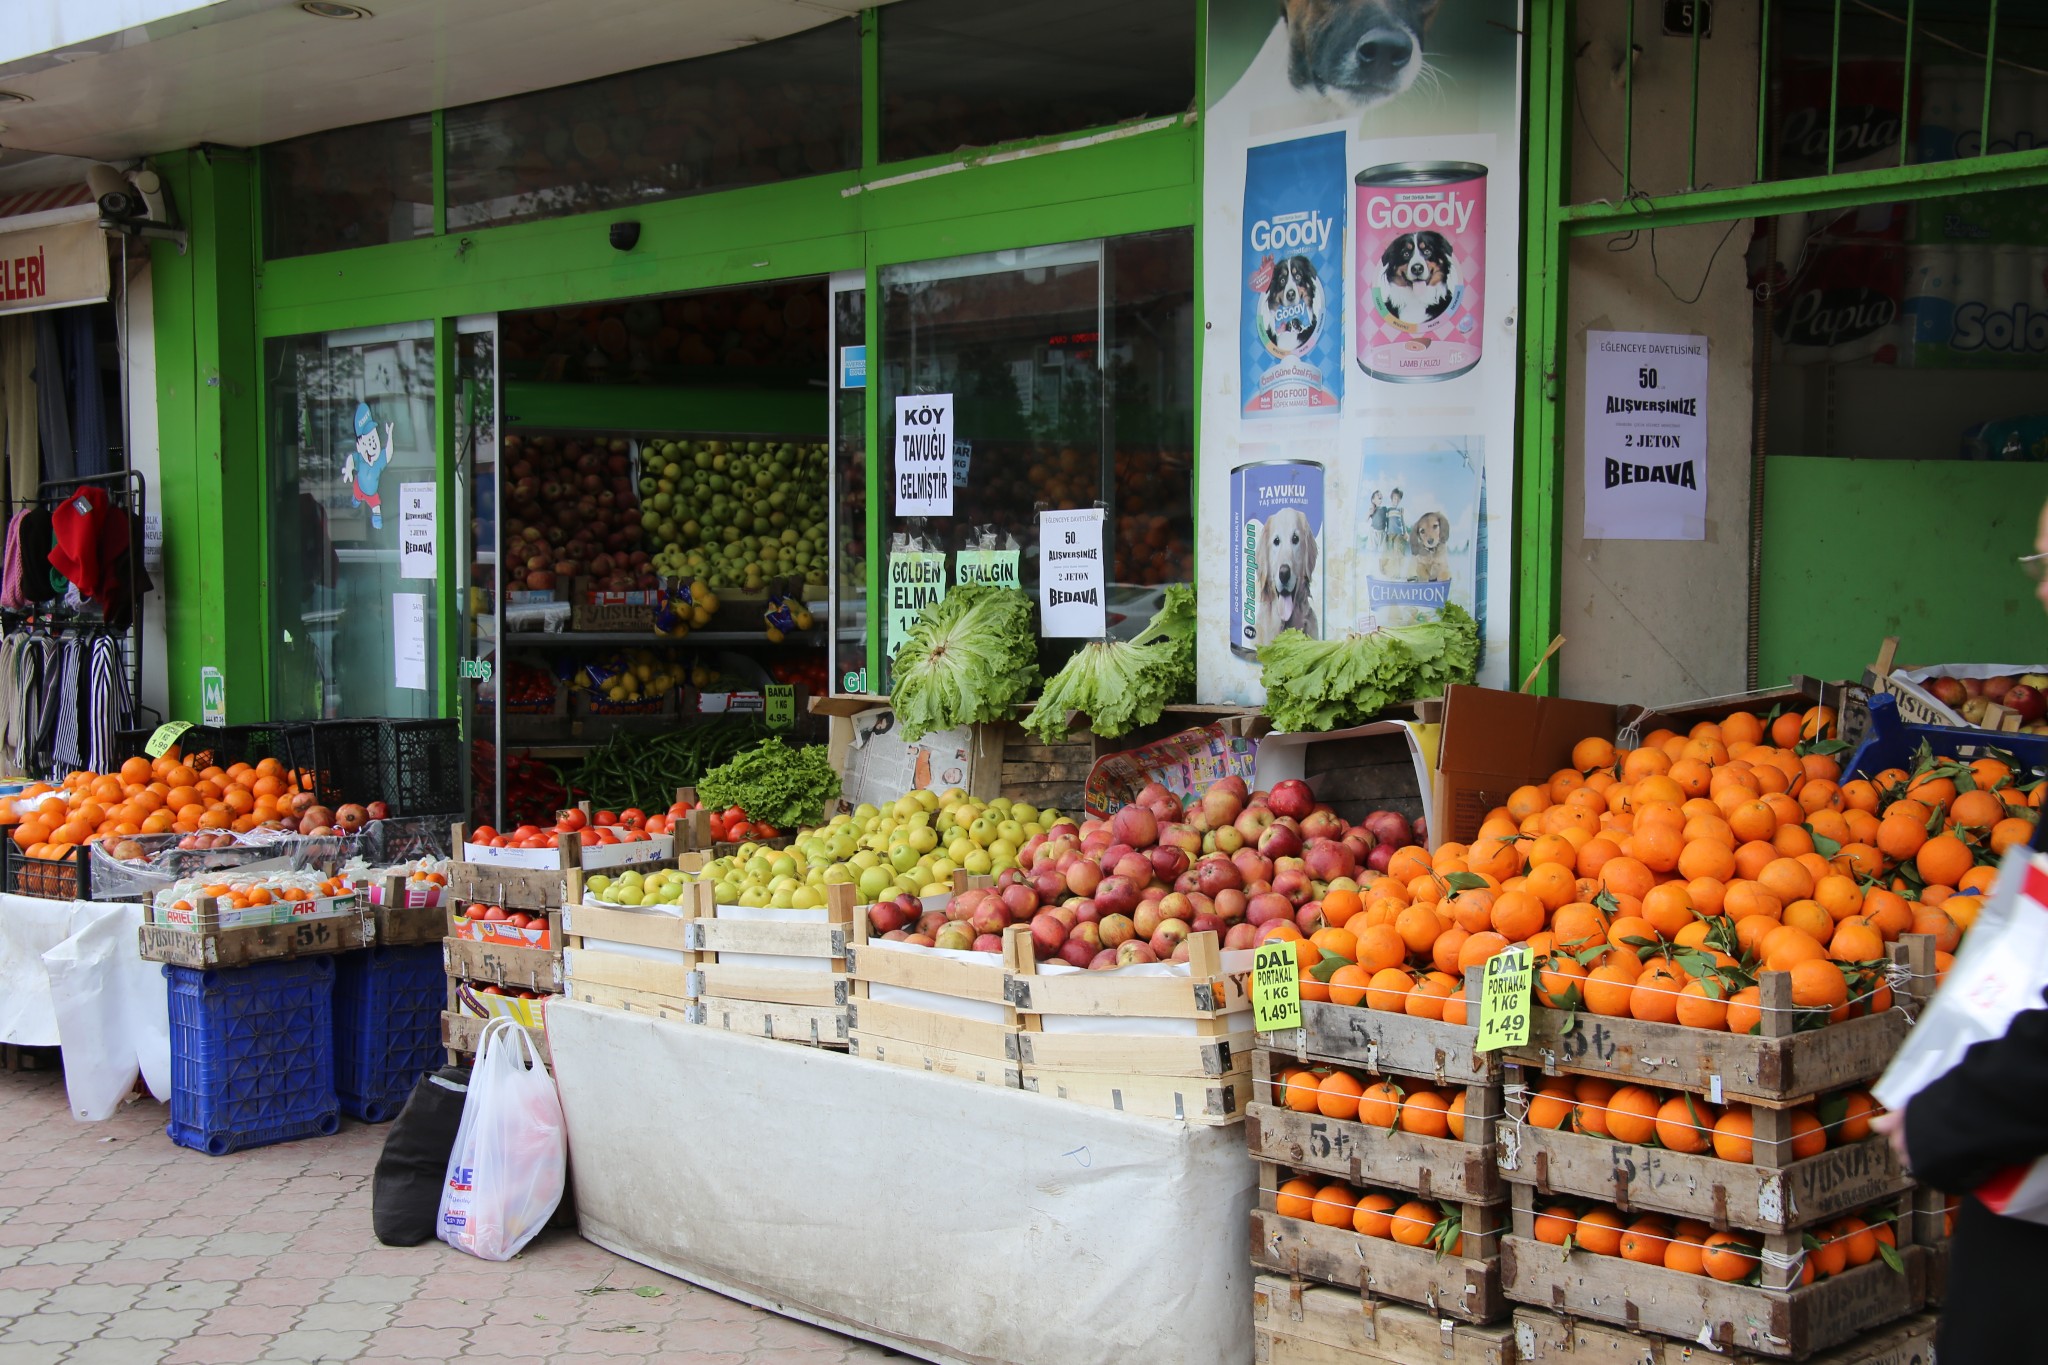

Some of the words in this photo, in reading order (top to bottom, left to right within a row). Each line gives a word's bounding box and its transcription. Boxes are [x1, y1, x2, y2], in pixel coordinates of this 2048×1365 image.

[1682, 4, 1693, 27] 5
[1367, 191, 1476, 234] Goody
[1250, 210, 1333, 252] Goody
[1275, 302, 1306, 322] Goody
[1780, 287, 1890, 347] Papia
[1600, 341, 1647, 353] EĞLENCEYE
[1649, 344, 1701, 355] DAVETLİSİNİZ
[1400, 360, 1418, 368] LAMB
[1424, 359, 1441, 367] KUZU
[1639, 368, 1658, 389] 50
[1273, 389, 1288, 398] DOG
[1289, 388, 1308, 398] FOOD
[904, 405, 945, 426] KÖY
[1606, 395, 1697, 417] ALIŞVERŞİNİZE
[903, 426, 946, 462] TAVUĞU
[1625, 434, 1633, 448] 2
[1636, 434, 1681, 449] JETON
[1605, 456, 1697, 491] BEDAVA
[900, 465, 948, 507] GELMİŞTİR
[1259, 485, 1306, 499] TAVUKLU
[413, 498, 421, 509] 50
[405, 540, 433, 556] BEDAVA
[1065, 531, 1076, 545] 50
[893, 561, 941, 584] GOLDEN
[960, 559, 1014, 583] STALGİN
[1058, 573, 1063, 581] 2
[1064, 572, 1089, 582] JETON
[1244, 523, 1259, 627] Champion
[894, 586, 939, 609] ELMA
[1049, 587, 1099, 607] BEDAVA
[1371, 585, 1445, 603] CHAMPION
[844, 667, 867, 693] Gİ
[768, 688, 793, 698] BAKLA
[780, 700, 788, 710] KG
[768, 714, 787, 723] 4.95
[166, 911, 194, 924] ARIEL
[1256, 950, 1295, 970] DAL
[1489, 951, 1530, 976] DAL
[1257, 966, 1293, 987] PORTAKAL
[1488, 974, 1527, 995] PORTAKAL
[1264, 989, 1269, 1001] 1
[1273, 986, 1289, 1000] KG
[1491, 996, 1497, 1013] 1
[1501, 993, 1518, 1011] KG
[1260, 1003, 1287, 1022] 1.49
[1287, 1002, 1299, 1014] TL
[1486, 1014, 1525, 1035] 1.49
[1505, 1033, 1522, 1041] TL
